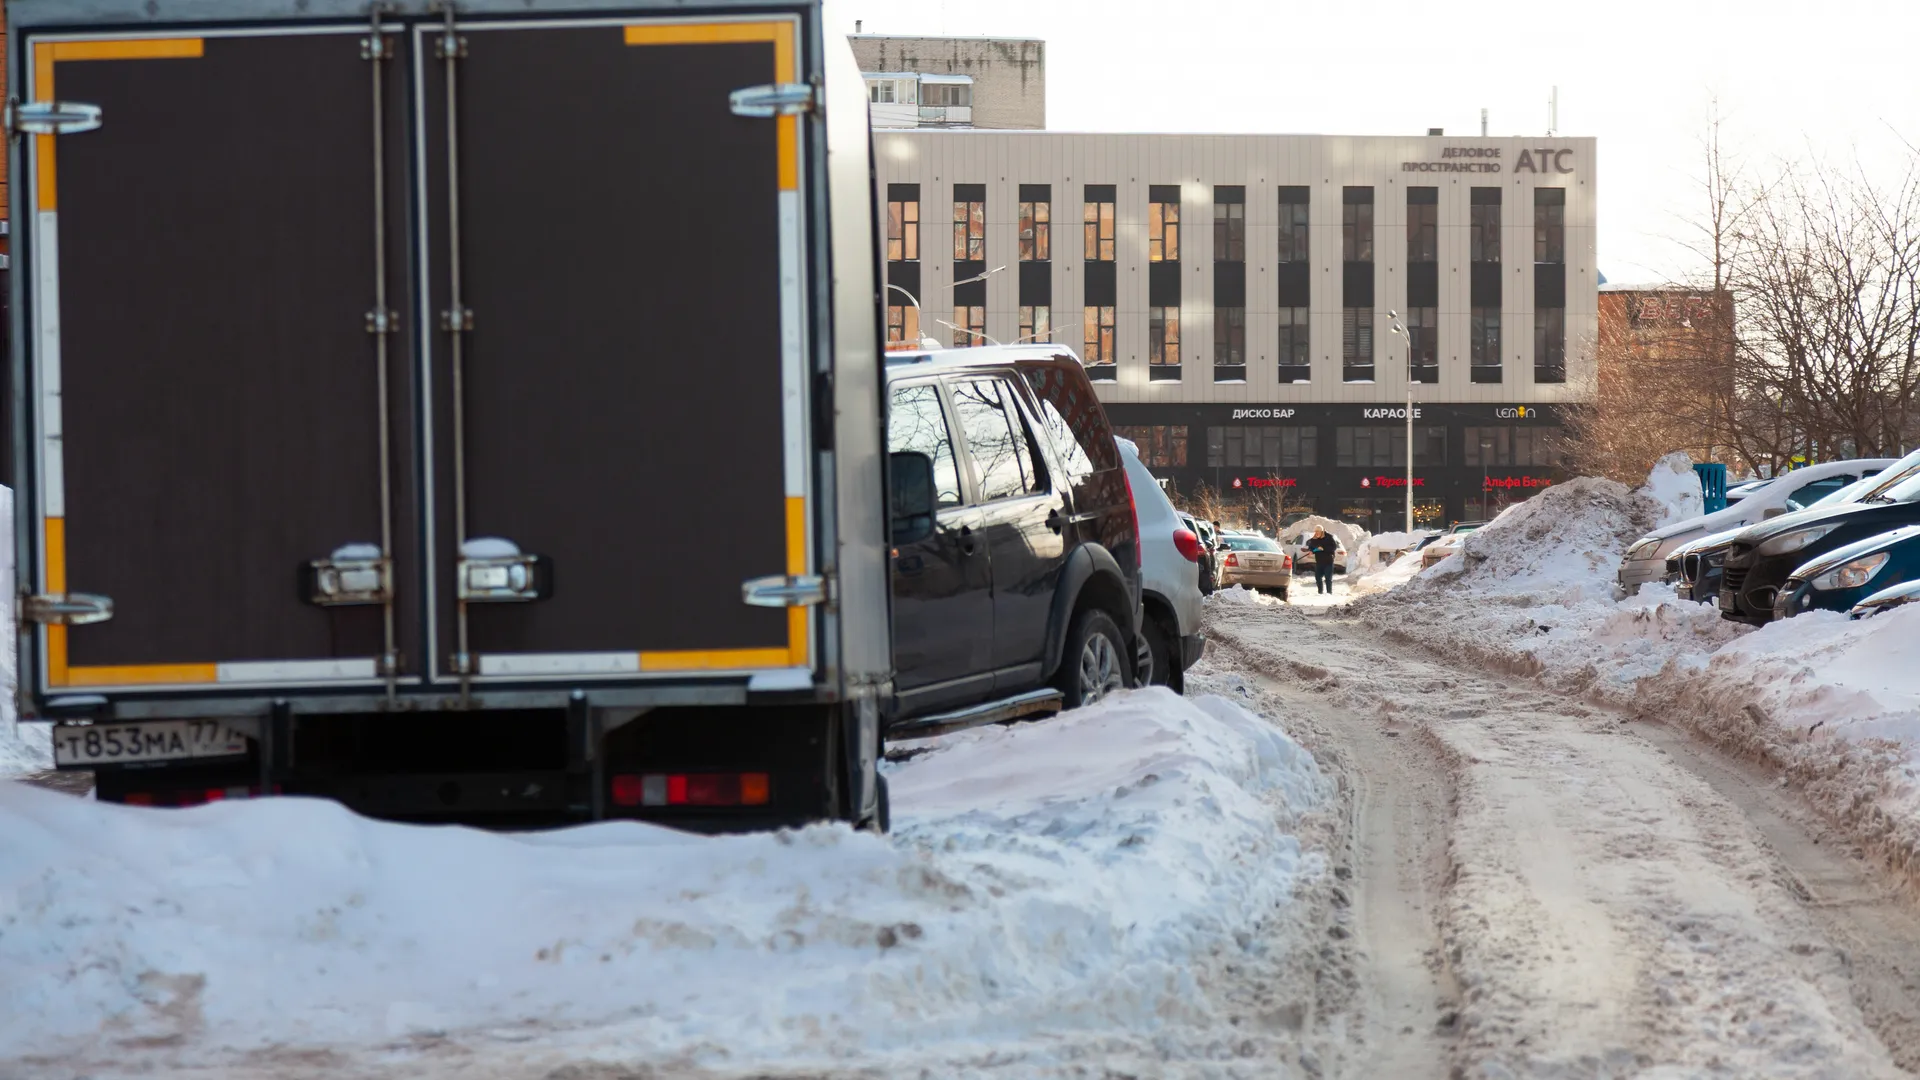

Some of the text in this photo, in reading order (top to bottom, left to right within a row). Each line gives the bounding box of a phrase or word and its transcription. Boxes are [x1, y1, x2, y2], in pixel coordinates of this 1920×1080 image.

[1442, 147, 1501, 159] ДЕЛОВОЕ
[1514, 148, 1574, 174] АТС
[1402, 162, 1500, 173] ПРОСТРАНСТВО
[1232, 409, 1295, 419] ДИСКО БАР
[1482, 475, 1521, 490] Альфа
